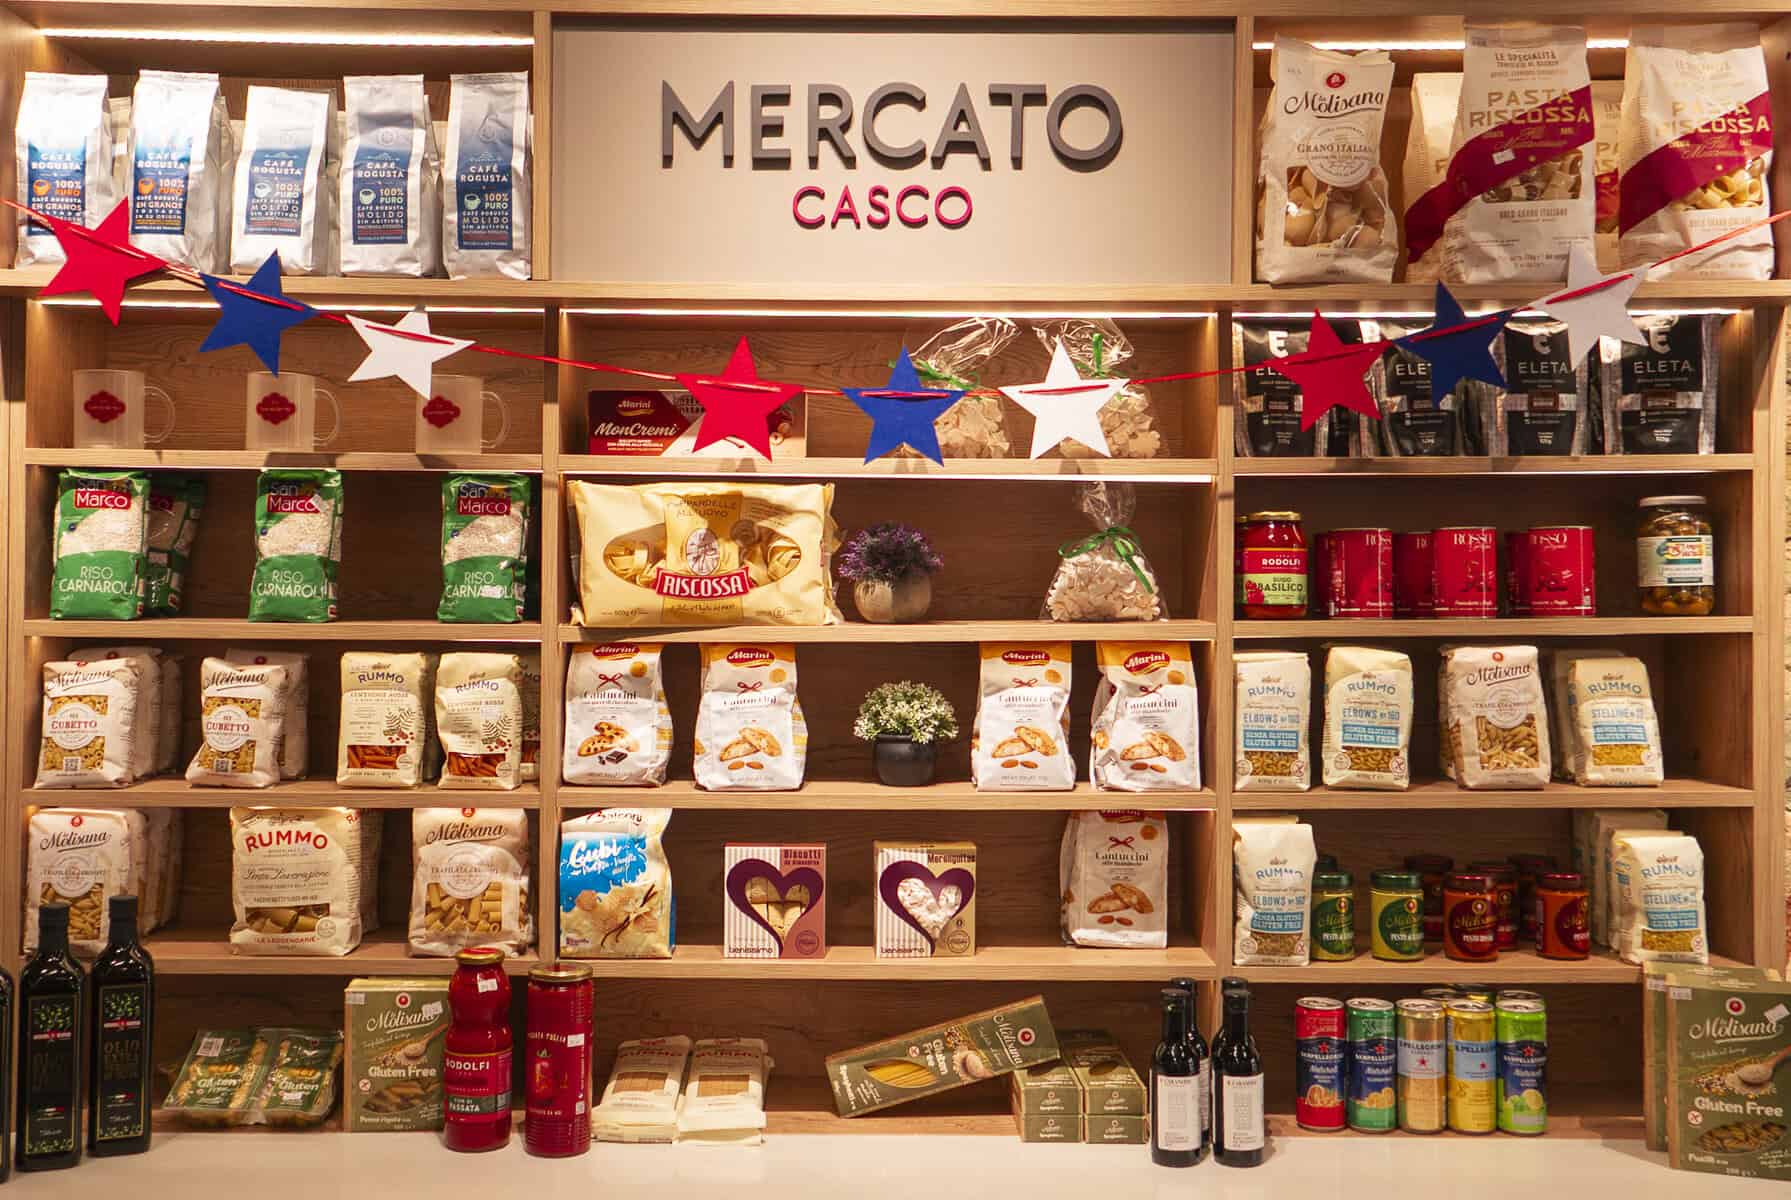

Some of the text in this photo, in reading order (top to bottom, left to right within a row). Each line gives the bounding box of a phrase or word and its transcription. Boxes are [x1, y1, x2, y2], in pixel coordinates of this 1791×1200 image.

[1487, 88, 1574, 107] PASTA
[1284, 91, 1385, 119] Molisana
[1671, 101, 1750, 116] PAA
[1469, 107, 1591, 128] RISCOSSA
[661, 79, 1124, 171] MERCATO
[1297, 143, 1334, 153] GRANO
[263, 159, 294, 168] CAFÉ
[366, 161, 396, 170] CAFÉ
[469, 164, 498, 174] CAFÉ
[55, 180, 81, 188] 100%
[159, 179, 185, 188] 100%
[275, 183, 301, 191] 100%
[274, 191, 299, 199] PURO
[379, 188, 404, 197] 100%
[484, 193, 509, 202] 100%
[379, 196, 404, 204] PURO
[484, 201, 509, 210] PURO
[791, 184, 974, 230] CASCO
[44, 203, 81, 212] GRANOS
[357, 211, 405, 219] MOLIDO
[462, 216, 509, 224] MOLIDO
[1395, 362, 1433, 376] ELE
[1518, 362, 1569, 375] ELETA
[1633, 360, 1692, 374] ELETA
[618, 399, 652, 410] Marini
[594, 422, 678, 437] MonCremi
[76, 492, 128, 508] Marco
[269, 496, 318, 512] Marco
[459, 499, 508, 514] Marco
[79, 566, 114, 580] RISO
[271, 569, 304, 584] RISO
[464, 571, 495, 585] RISO
[446, 583, 513, 599] CARNALI
[662, 576, 745, 597] RISCOSSA
[729, 651, 771, 660] Marini
[1004, 651, 1047, 661] Marini
[1125, 653, 1166, 669] Marini
[358, 671, 405, 685] RUMMO
[1466, 664, 1533, 686] Molisana
[455, 679, 500, 693] RUMMO
[1347, 681, 1397, 695] RUMMO
[1587, 682, 1642, 695] RUMMO
[1243, 713, 1278, 724] ELBOWS
[425, 822, 508, 846] Molisana
[40, 831, 112, 852] Molisana
[245, 830, 328, 853] RUMMO
[1095, 851, 1149, 862] Cantuccini
[1688, 1015, 1778, 1044] Molisana
[932, 1038, 949, 1076] Gluten
[368, 1064, 437, 1078] Gluten Free
[279, 1079, 320, 1092] Gluten
[1694, 1096, 1784, 1118] Gluten Free
